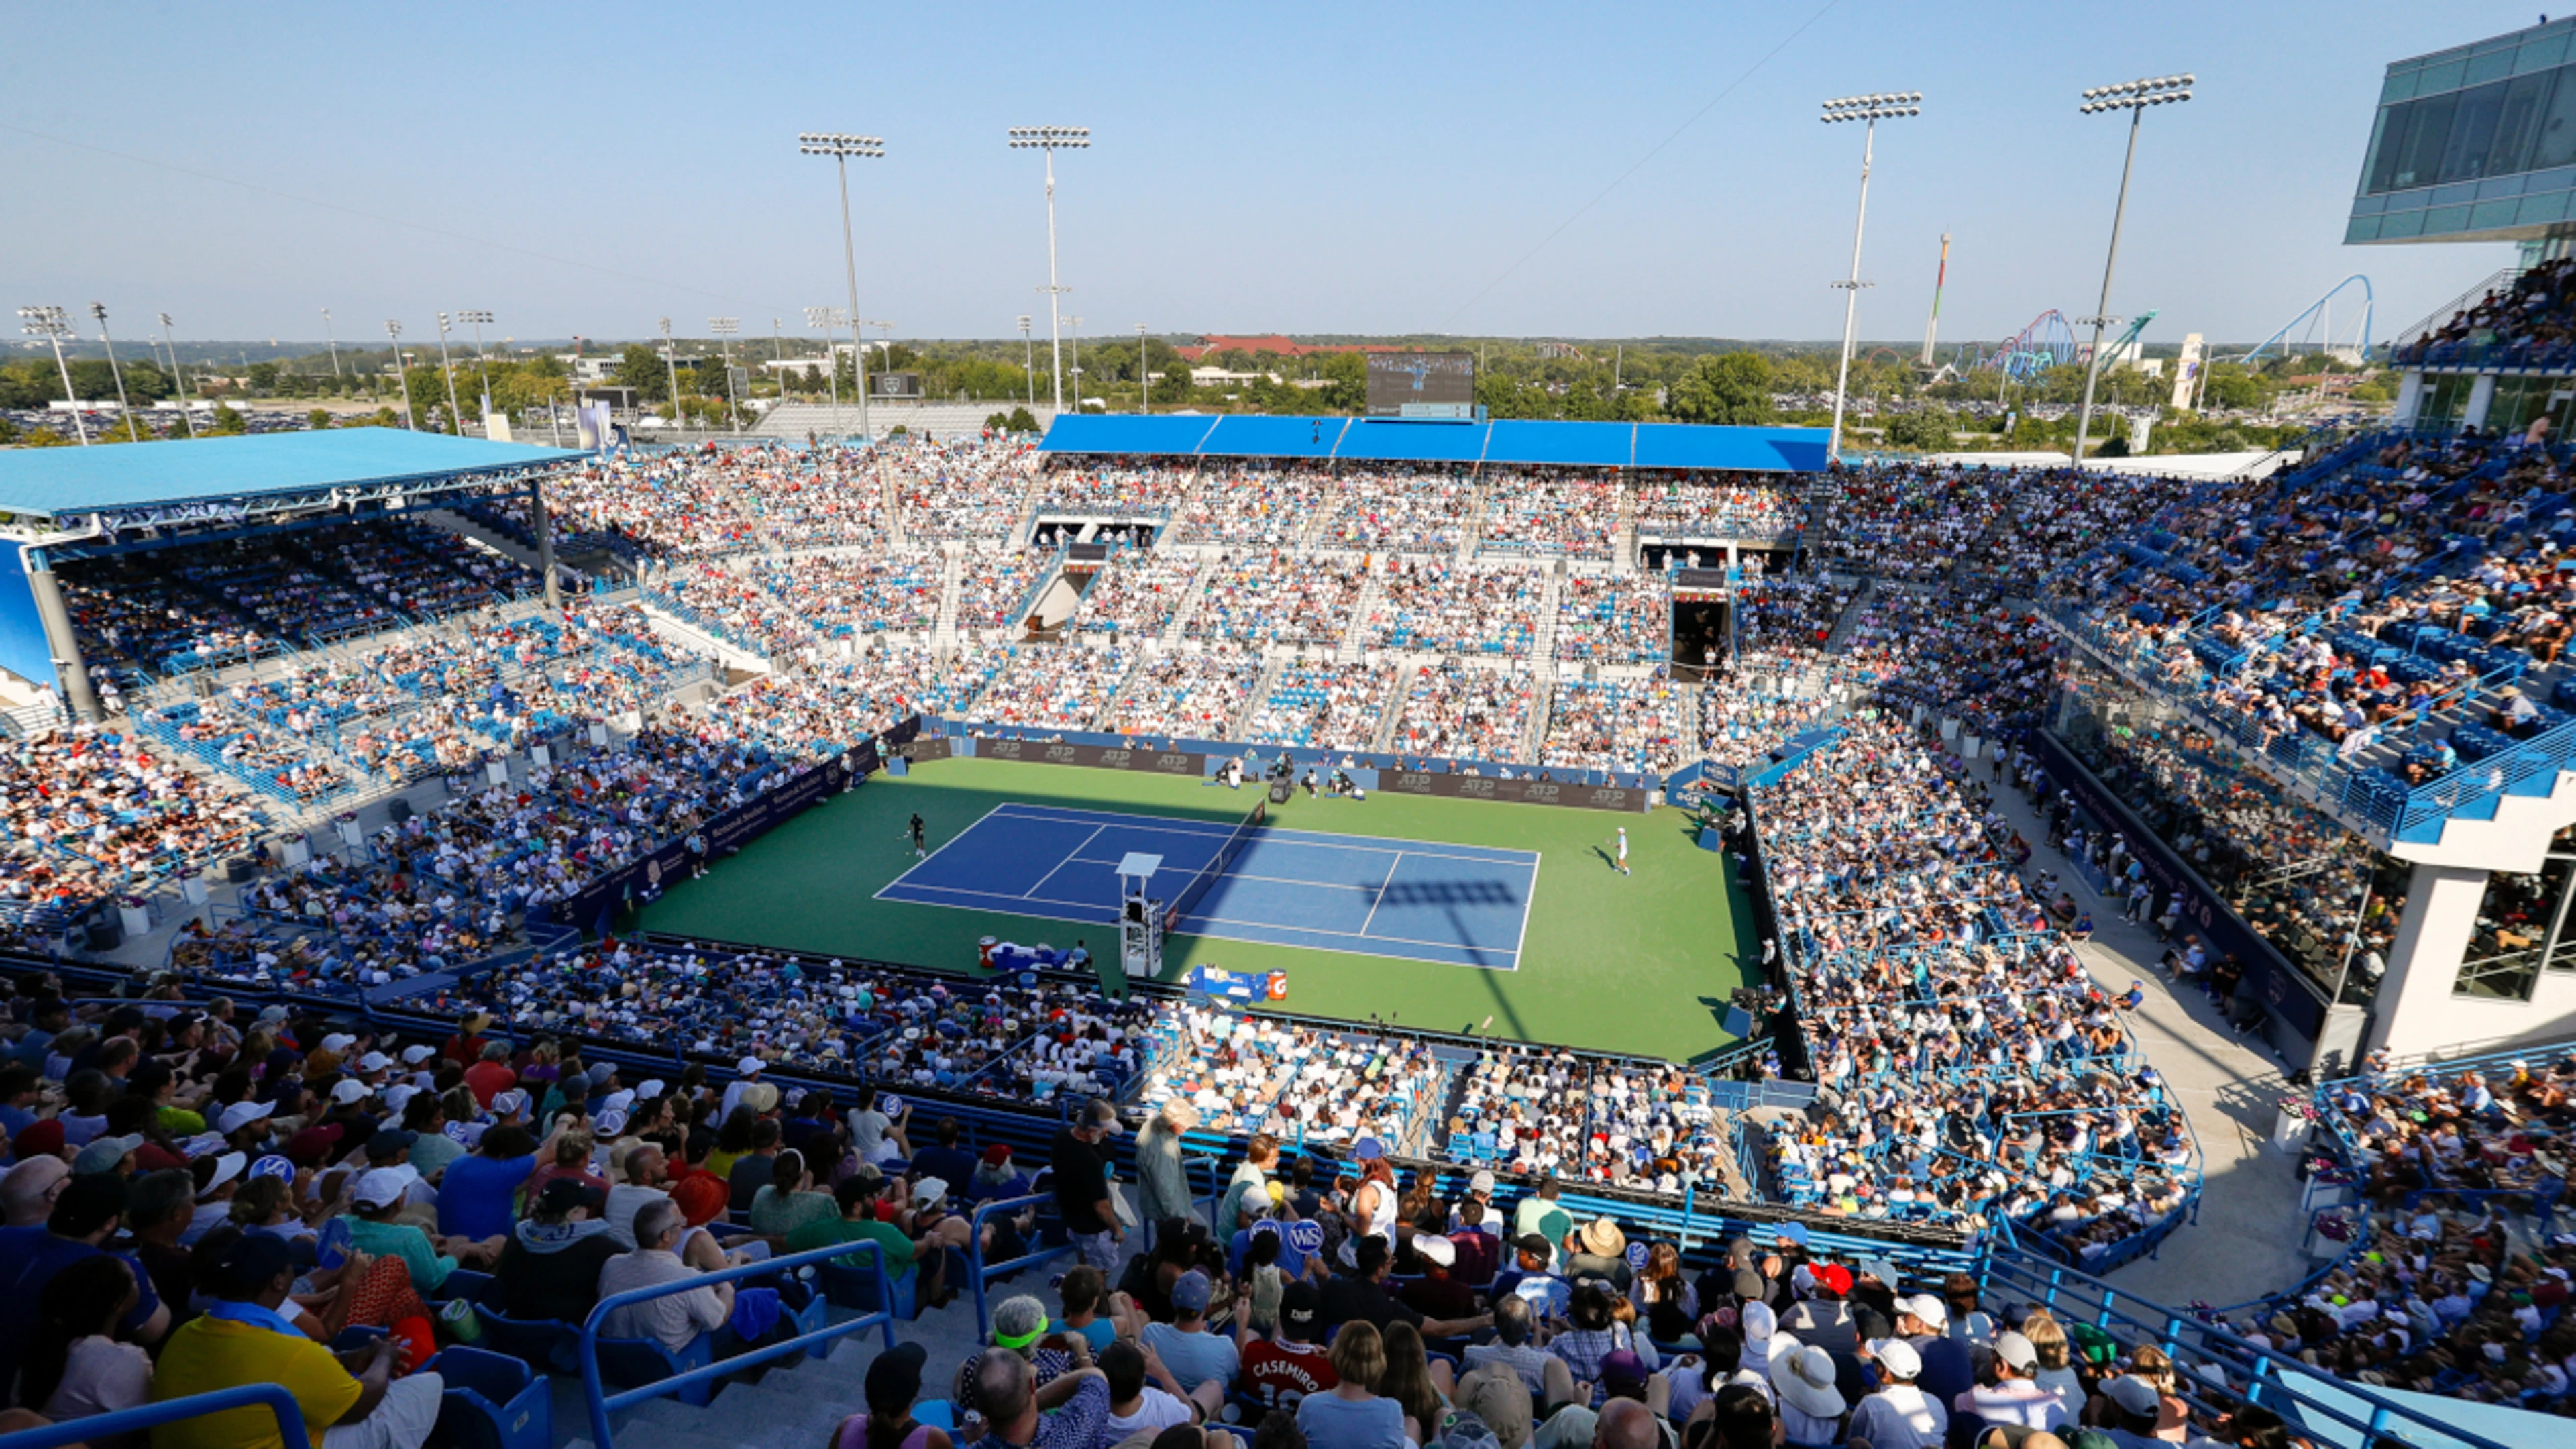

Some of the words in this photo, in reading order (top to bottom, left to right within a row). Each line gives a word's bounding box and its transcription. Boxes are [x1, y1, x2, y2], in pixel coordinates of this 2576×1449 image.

[992, 741, 1020, 754] ATP
[1046, 745, 1075, 757] ATP
[1102, 749, 1130, 762] ATP
[1158, 755, 1187, 767] ATP
[1397, 773, 1430, 786] ATP
[1461, 779, 1495, 791] ATP
[1525, 784, 1559, 796] ATP
[1590, 789, 1625, 801] ATP
[1253, 1360, 1319, 1392] CASEMIRO
